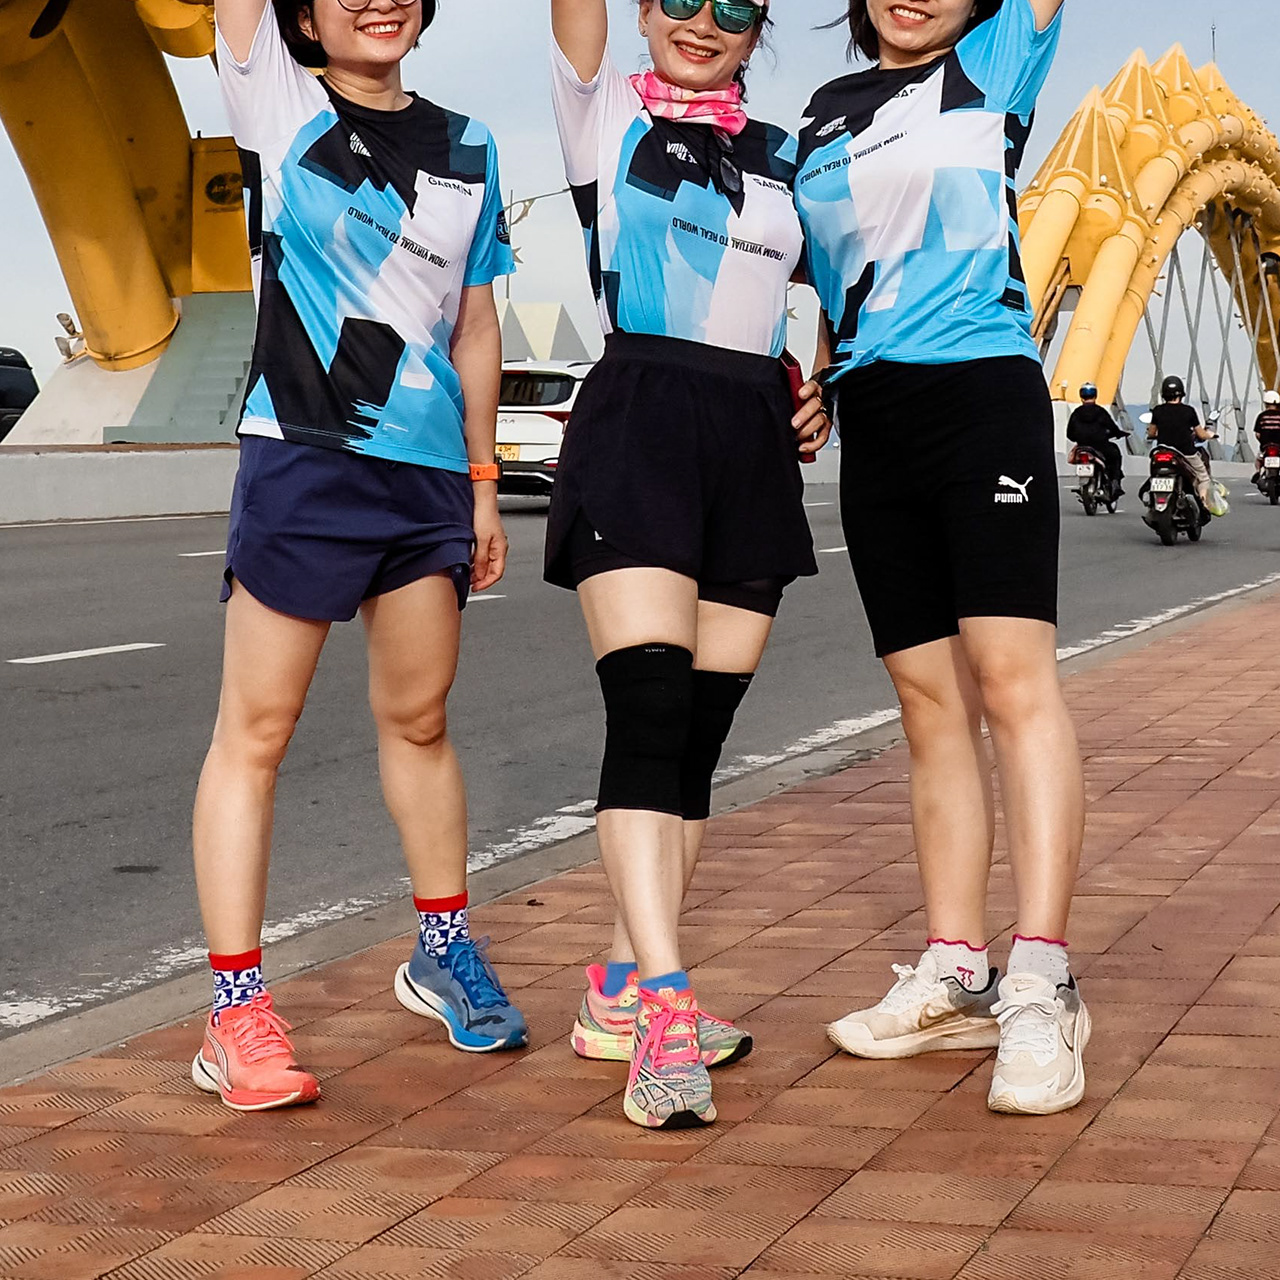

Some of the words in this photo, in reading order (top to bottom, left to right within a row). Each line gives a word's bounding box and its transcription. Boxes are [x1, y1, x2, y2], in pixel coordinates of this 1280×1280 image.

[347, 206, 374, 227] WORLD
[672, 217, 699, 236] WORLD
[389, 232, 400, 244] TO
[699, 227, 718, 243] REAL
[718, 235, 729, 247] TO
[731, 237, 763, 256] VIRTUAL
[994, 493, 1023, 504] PUMA
